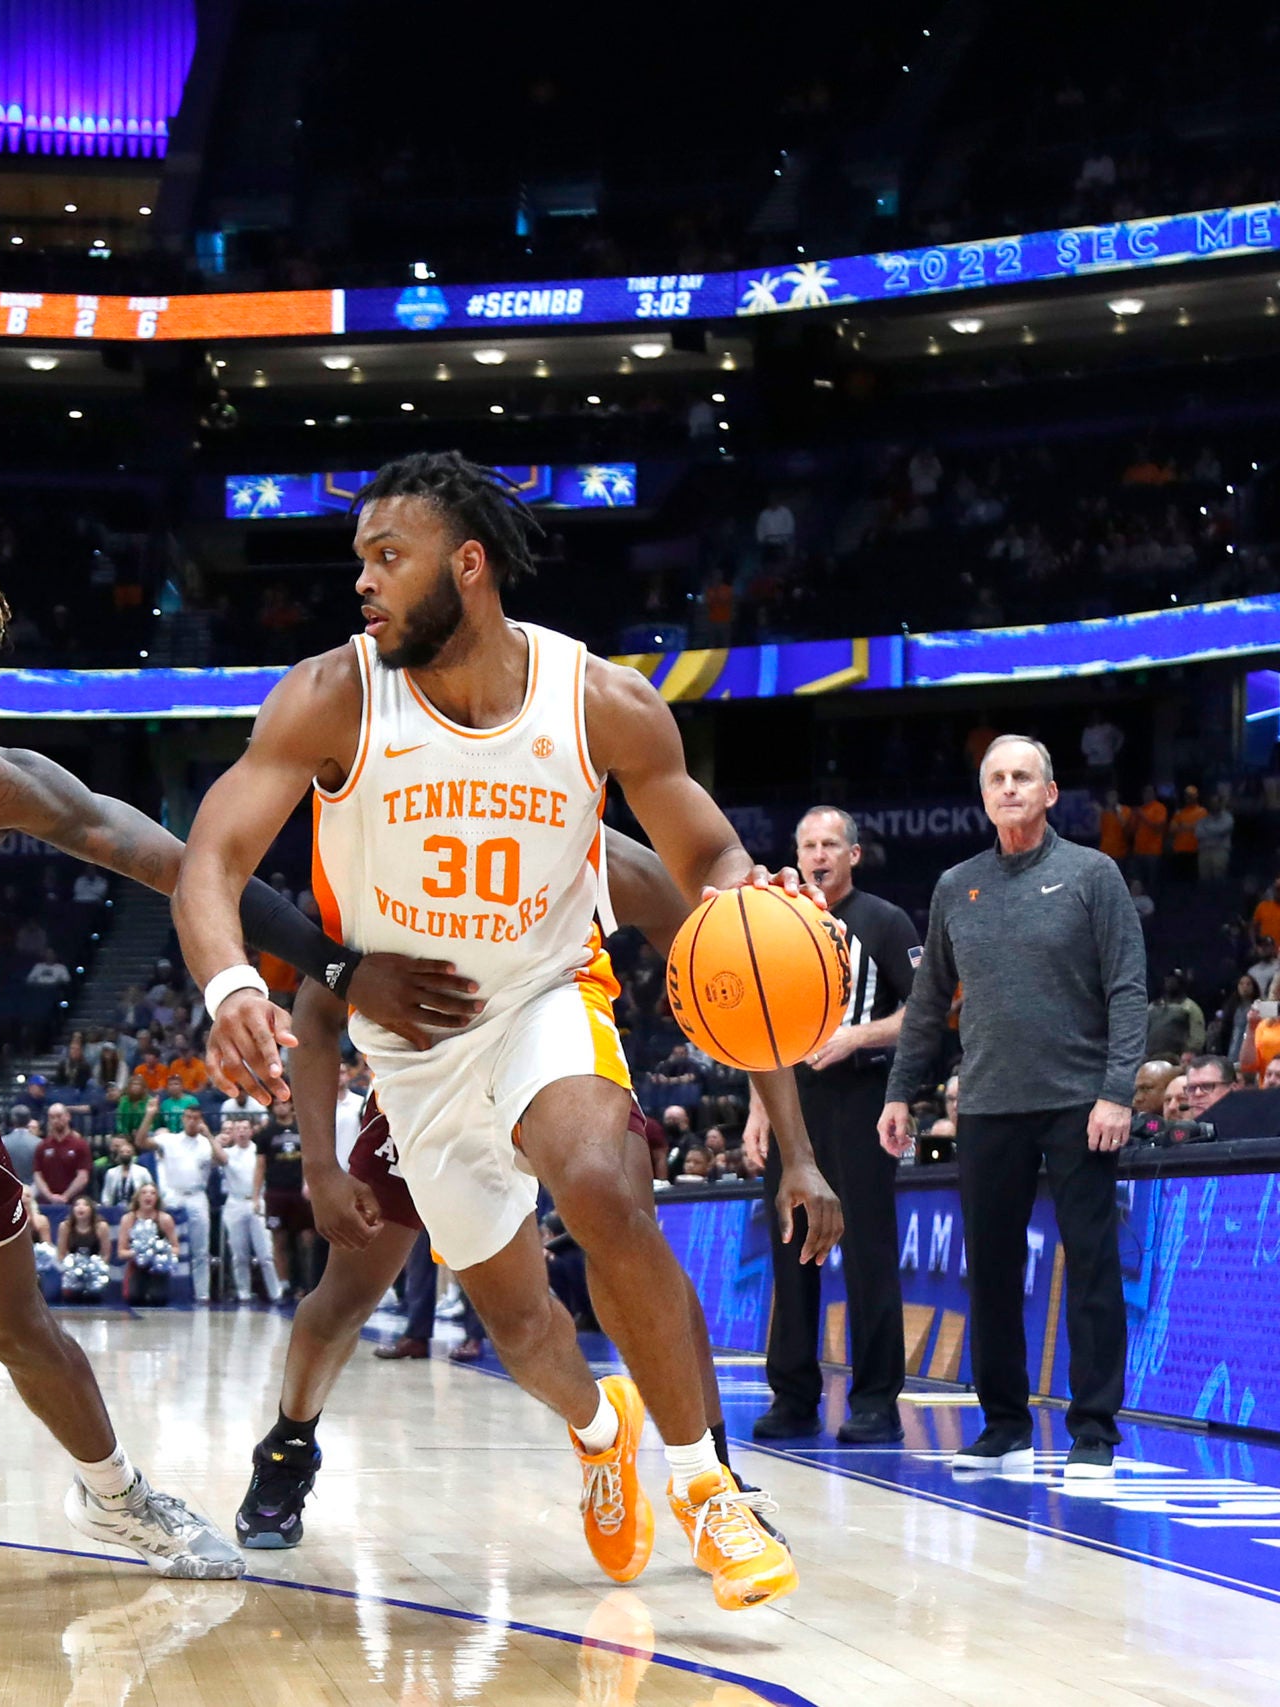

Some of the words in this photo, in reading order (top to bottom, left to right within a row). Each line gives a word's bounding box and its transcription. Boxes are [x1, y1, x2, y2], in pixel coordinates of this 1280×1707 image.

[883, 239, 1021, 290] 2022
[1056, 222, 1159, 267] SEC
[626, 277, 657, 292] TIME
[679, 274, 704, 290] DAY
[466, 287, 584, 318] #SECMBB
[635, 291, 691, 318] 3:03
[74, 309, 97, 338] 2
[136, 311, 159, 339] 6
[532, 737, 553, 757] SEC
[383, 780, 568, 828] TENNESSEE
[853, 806, 989, 837] ENTUCKY
[422, 834, 520, 906] 30
[967, 889, 980, 902] T
